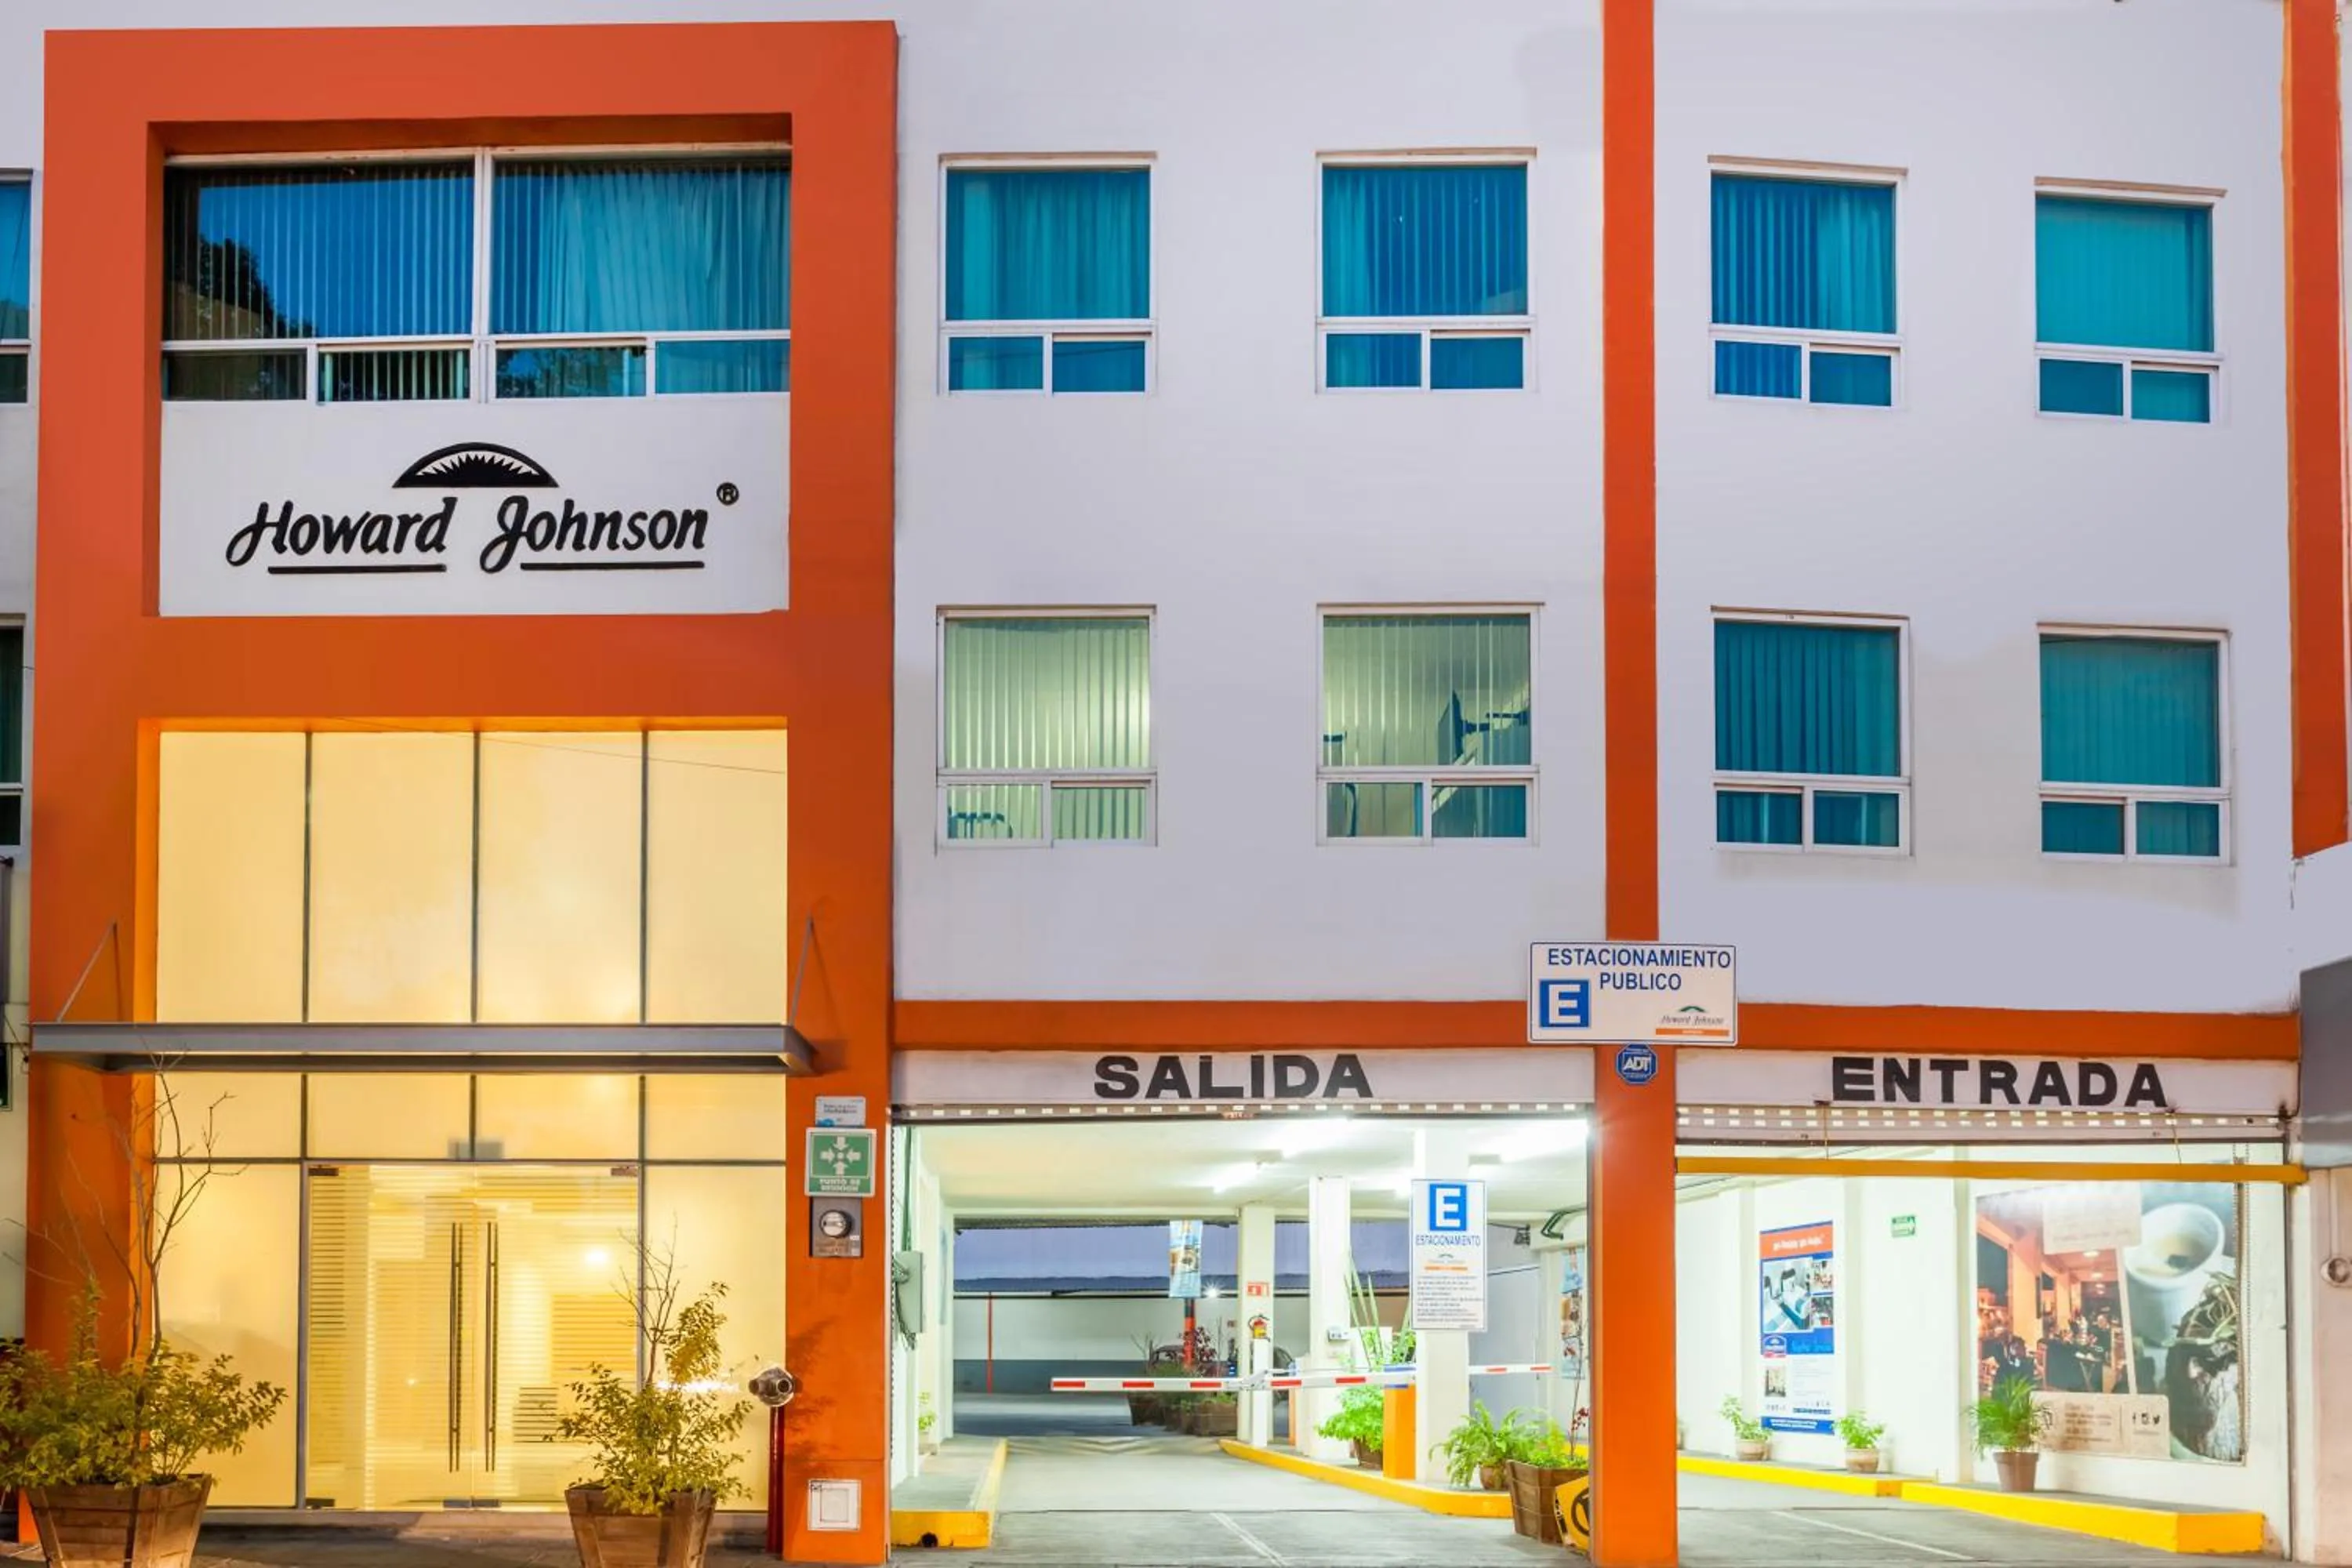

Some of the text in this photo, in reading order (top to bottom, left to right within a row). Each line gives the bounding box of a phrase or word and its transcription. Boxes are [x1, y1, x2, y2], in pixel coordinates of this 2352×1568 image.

[226, 495, 458, 567] Howard
[480, 495, 708, 573] Johnson
[1548, 948, 1731, 968] ESTACIONAMIENTO
[1599, 972, 1682, 990] PUBLICO
[1548, 984, 1581, 1024] E
[1093, 1054, 1374, 1099] SALIDA
[1622, 1055, 1650, 1072] ADT
[1831, 1056, 2169, 1108] ENTRADA
[1435, 1187, 1461, 1228] E
[1415, 1235, 1481, 1247] ESTACIONAMIENTO
